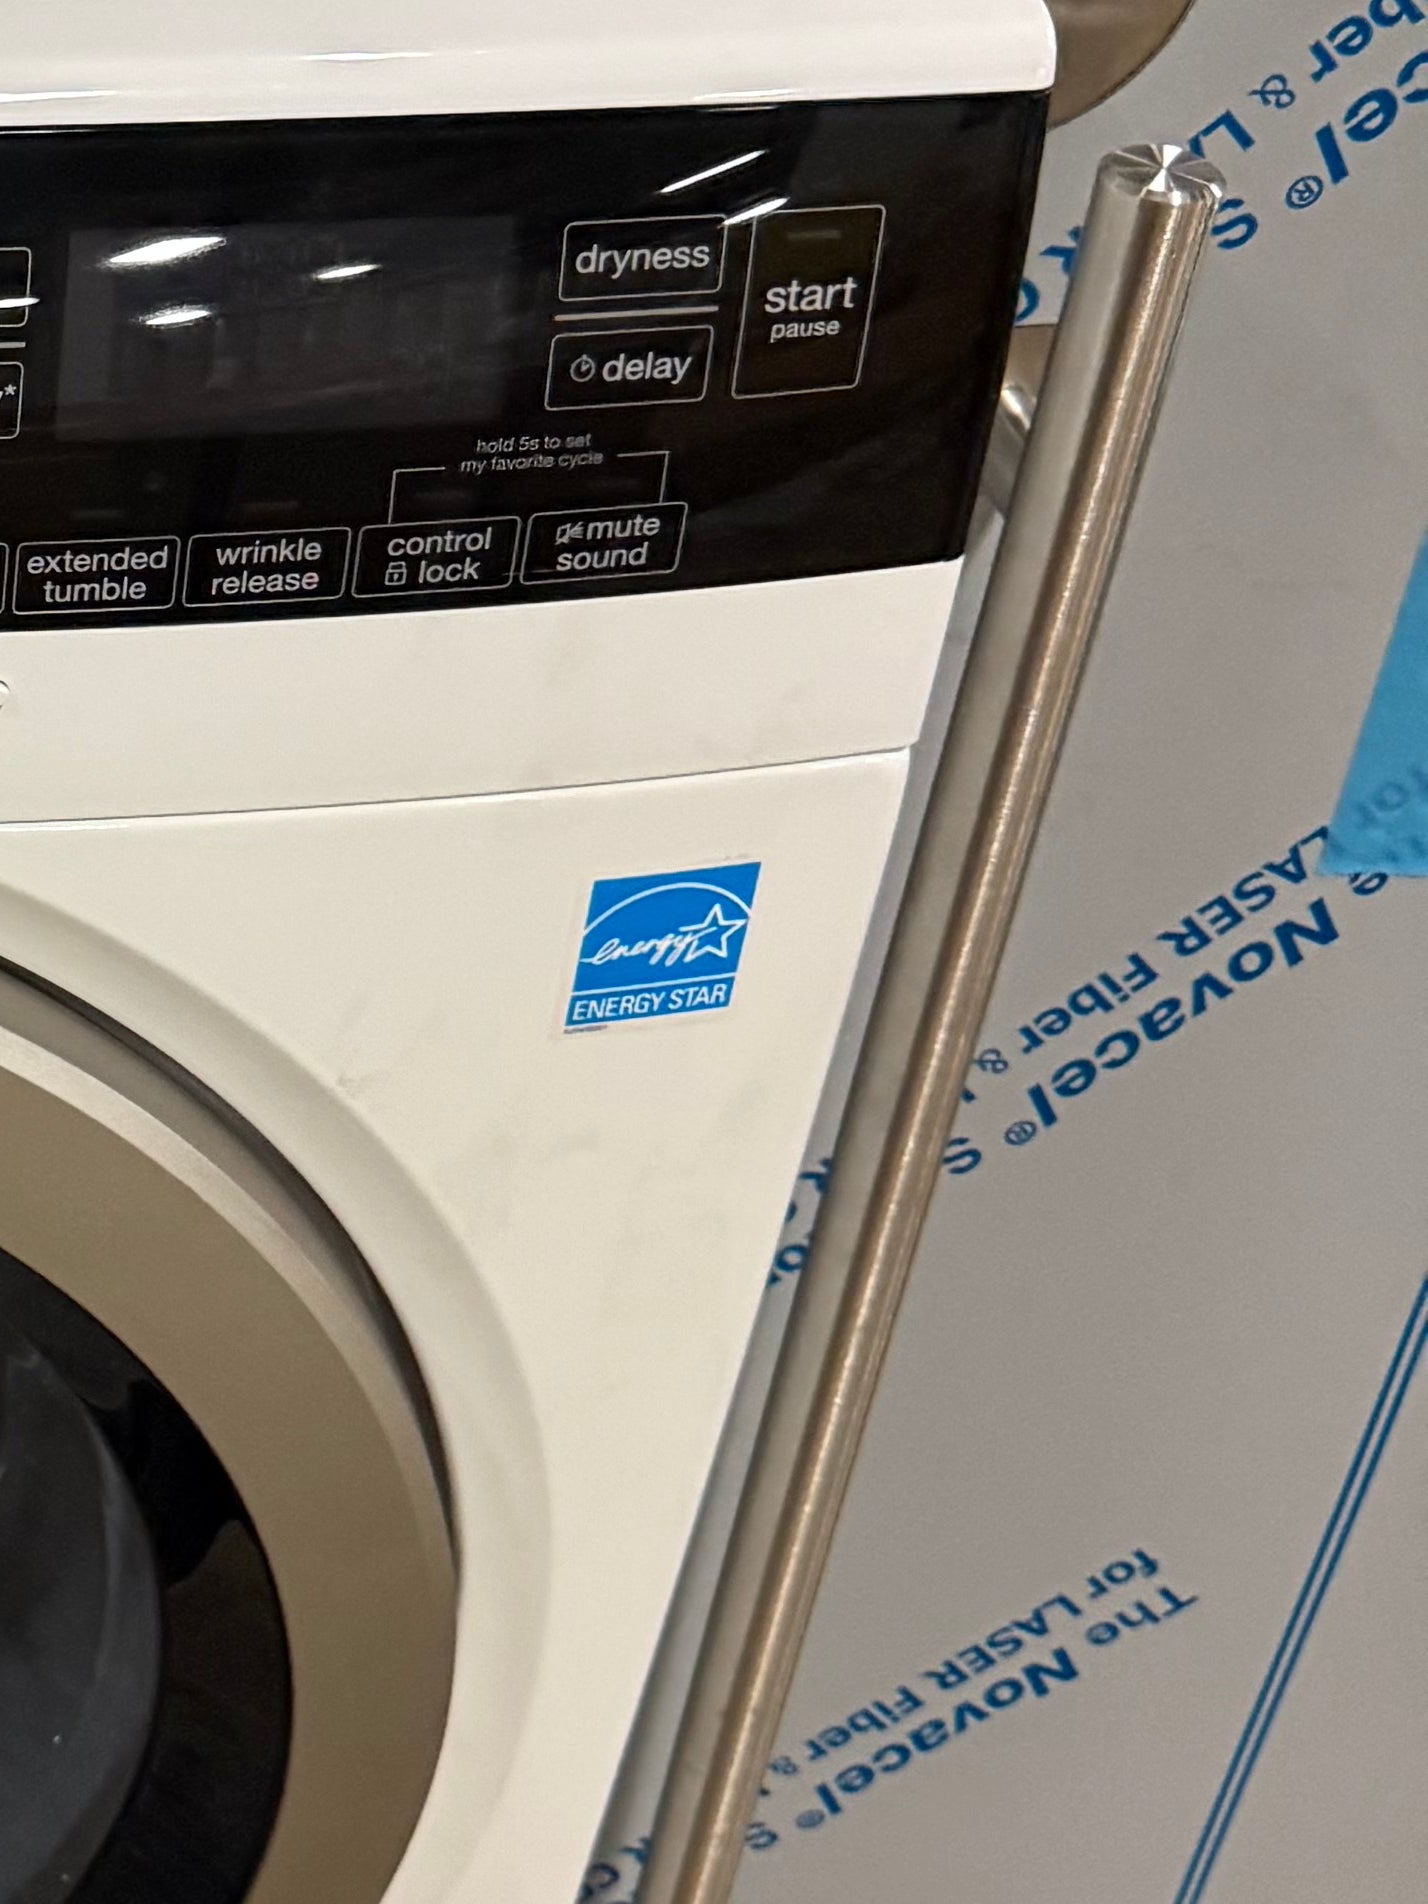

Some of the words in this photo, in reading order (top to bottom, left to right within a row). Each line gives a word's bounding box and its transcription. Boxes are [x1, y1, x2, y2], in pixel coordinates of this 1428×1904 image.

[575, 240, 711, 280] dryness
[764, 277, 858, 314] start
[769, 318, 841, 343] pause
[602, 352, 692, 384] delay
[544, 436, 561, 449] to
[460, 459, 487, 475] my
[558, 449, 604, 470] cycle
[387, 527, 492, 557] control
[586, 514, 661, 541] mute
[26, 545, 168, 575] extended
[215, 537, 322, 567] wrinkle
[556, 542, 648, 571] sound
[211, 568, 319, 596] release
[418, 557, 480, 584] lock
[43, 576, 147, 604] tumble
[572, 992, 665, 1021] ENERGY
[668, 982, 728, 1010] STAR
[1018, 952, 1159, 1054] Fiber
[1085, 1547, 1160, 1601] for
[1085, 1585, 1200, 1646] The
[922, 1593, 1083, 1691] LASER
[804, 1685, 926, 1762] Fiber
